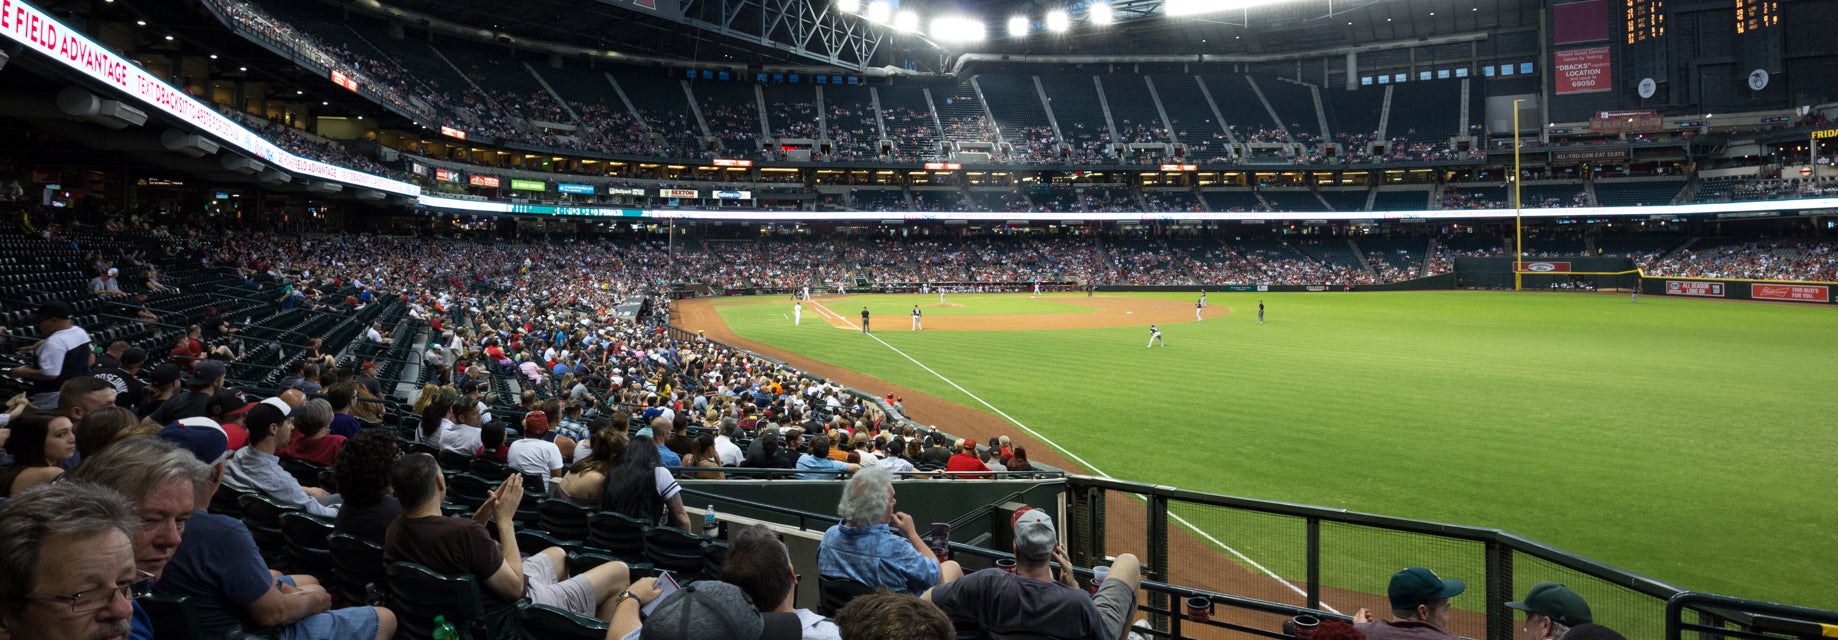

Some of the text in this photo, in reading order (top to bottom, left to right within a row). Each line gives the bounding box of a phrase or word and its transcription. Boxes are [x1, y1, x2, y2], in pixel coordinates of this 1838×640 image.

[16, 7, 57, 50] FIELD
[60, 32, 127, 86] ADVANTAGE
[137, 75, 154, 97] TEXT
[308, 163, 337, 178] ADVANTAGE
[1565, 69, 1601, 77] LOCATION
